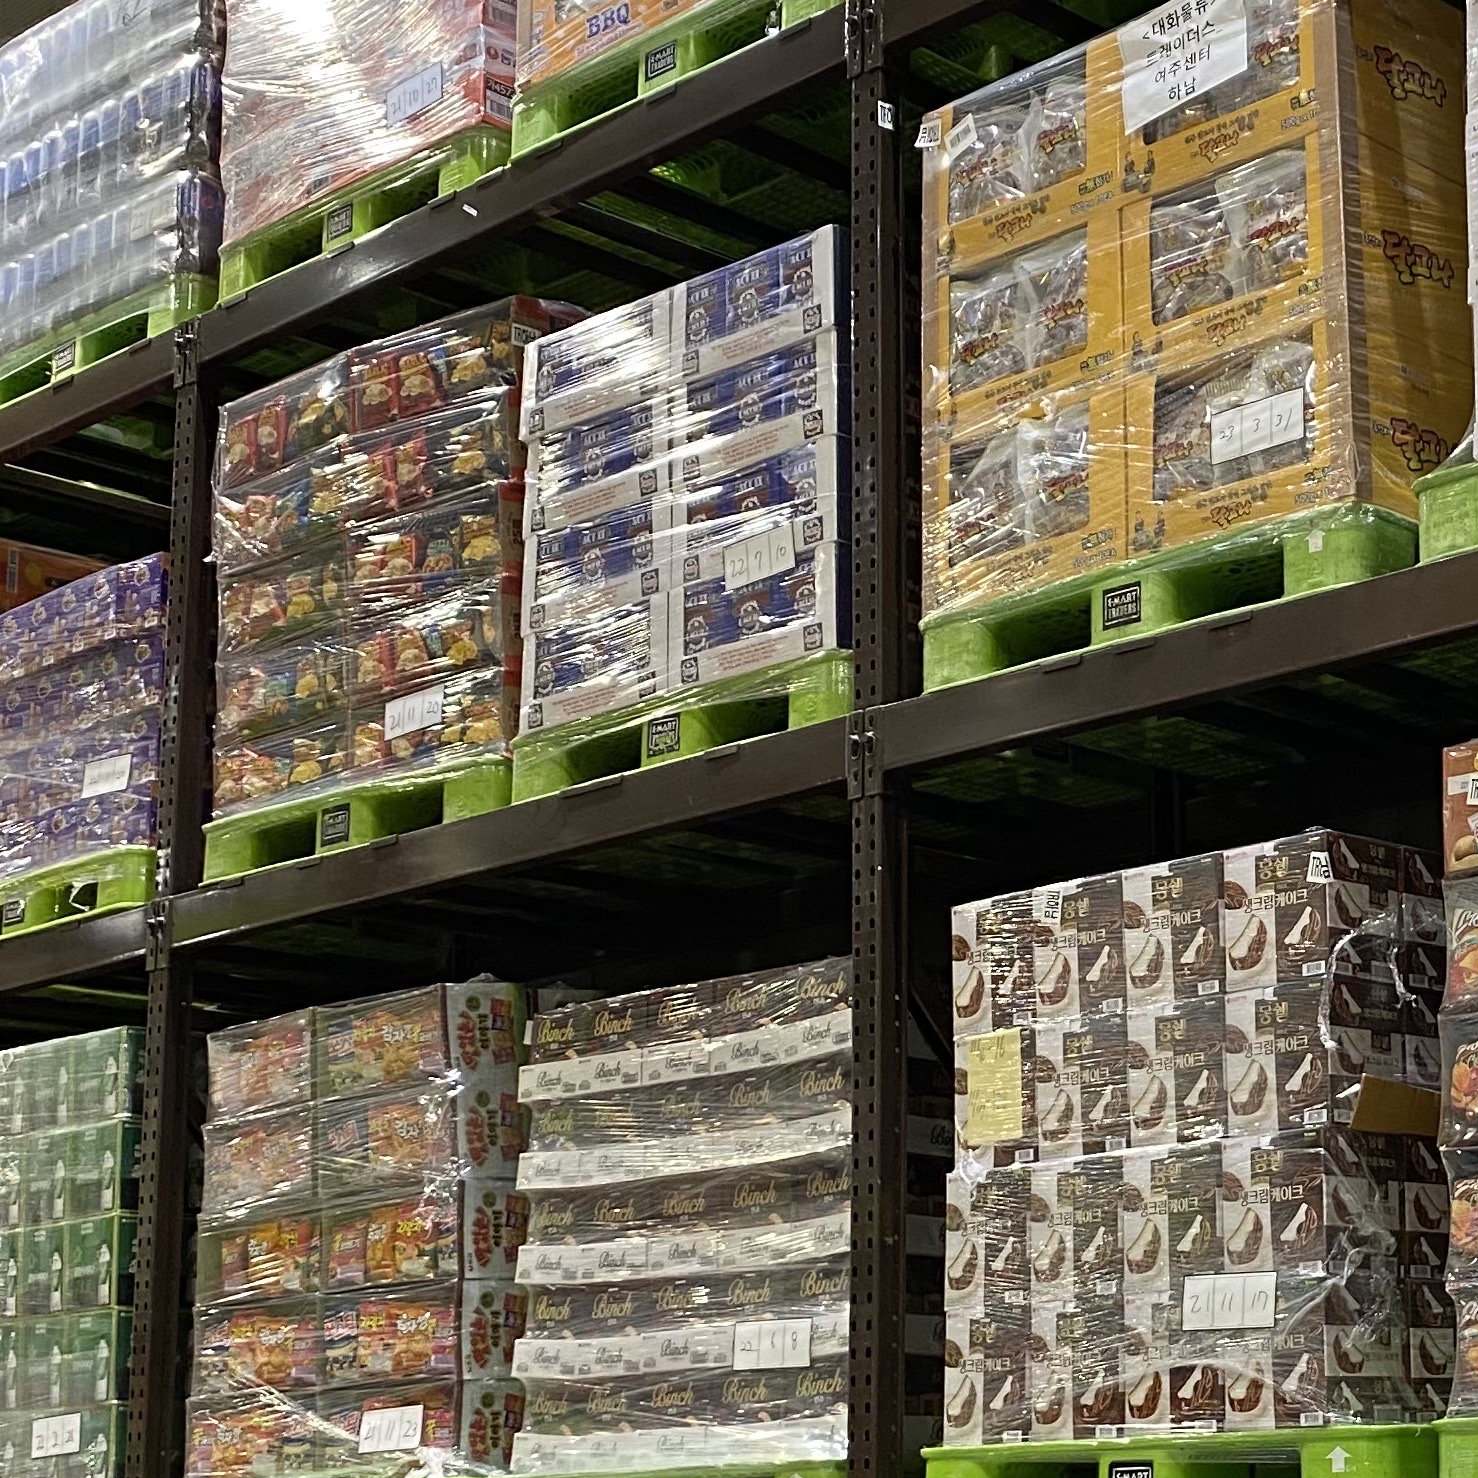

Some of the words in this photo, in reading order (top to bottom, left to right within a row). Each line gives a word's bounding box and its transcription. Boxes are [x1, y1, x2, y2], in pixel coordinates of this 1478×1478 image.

[586, 2, 631, 39] BBQ
[1154, 44, 1211, 83] 여주센터
[1373, 44, 1446, 107] 달고나
[1168, 77, 1196, 100] 하남
[1380, 229, 1454, 289] 달고나
[728, 558, 746, 577] 22
[427, 701, 438, 714] 20
[1258, 856, 1289, 879] 몽쉘
[1153, 878, 1184, 899] 몽쉘
[1063, 898, 1090, 919] 몽쉘
[593, 1008, 633, 1037] Binch
[1258, 1002, 1289, 1022] 몽쉘
[537, 1018, 576, 1042] Binch
[1158, 1019, 1187, 1040] 몽쉘
[800, 1066, 846, 1095] Binch
[1252, 1151, 1284, 1173] 몽쉘
[733, 1181, 777, 1208] Binch
[807, 1172, 850, 1198] Binch
[728, 1278, 772, 1305] Binch
[800, 1268, 850, 1298] Binch
[592, 1293, 634, 1319] Binch
[1189, 1294, 1210, 1314] 21
[722, 1376, 768, 1402] Binch
[402, 1420, 417, 1438] 23
